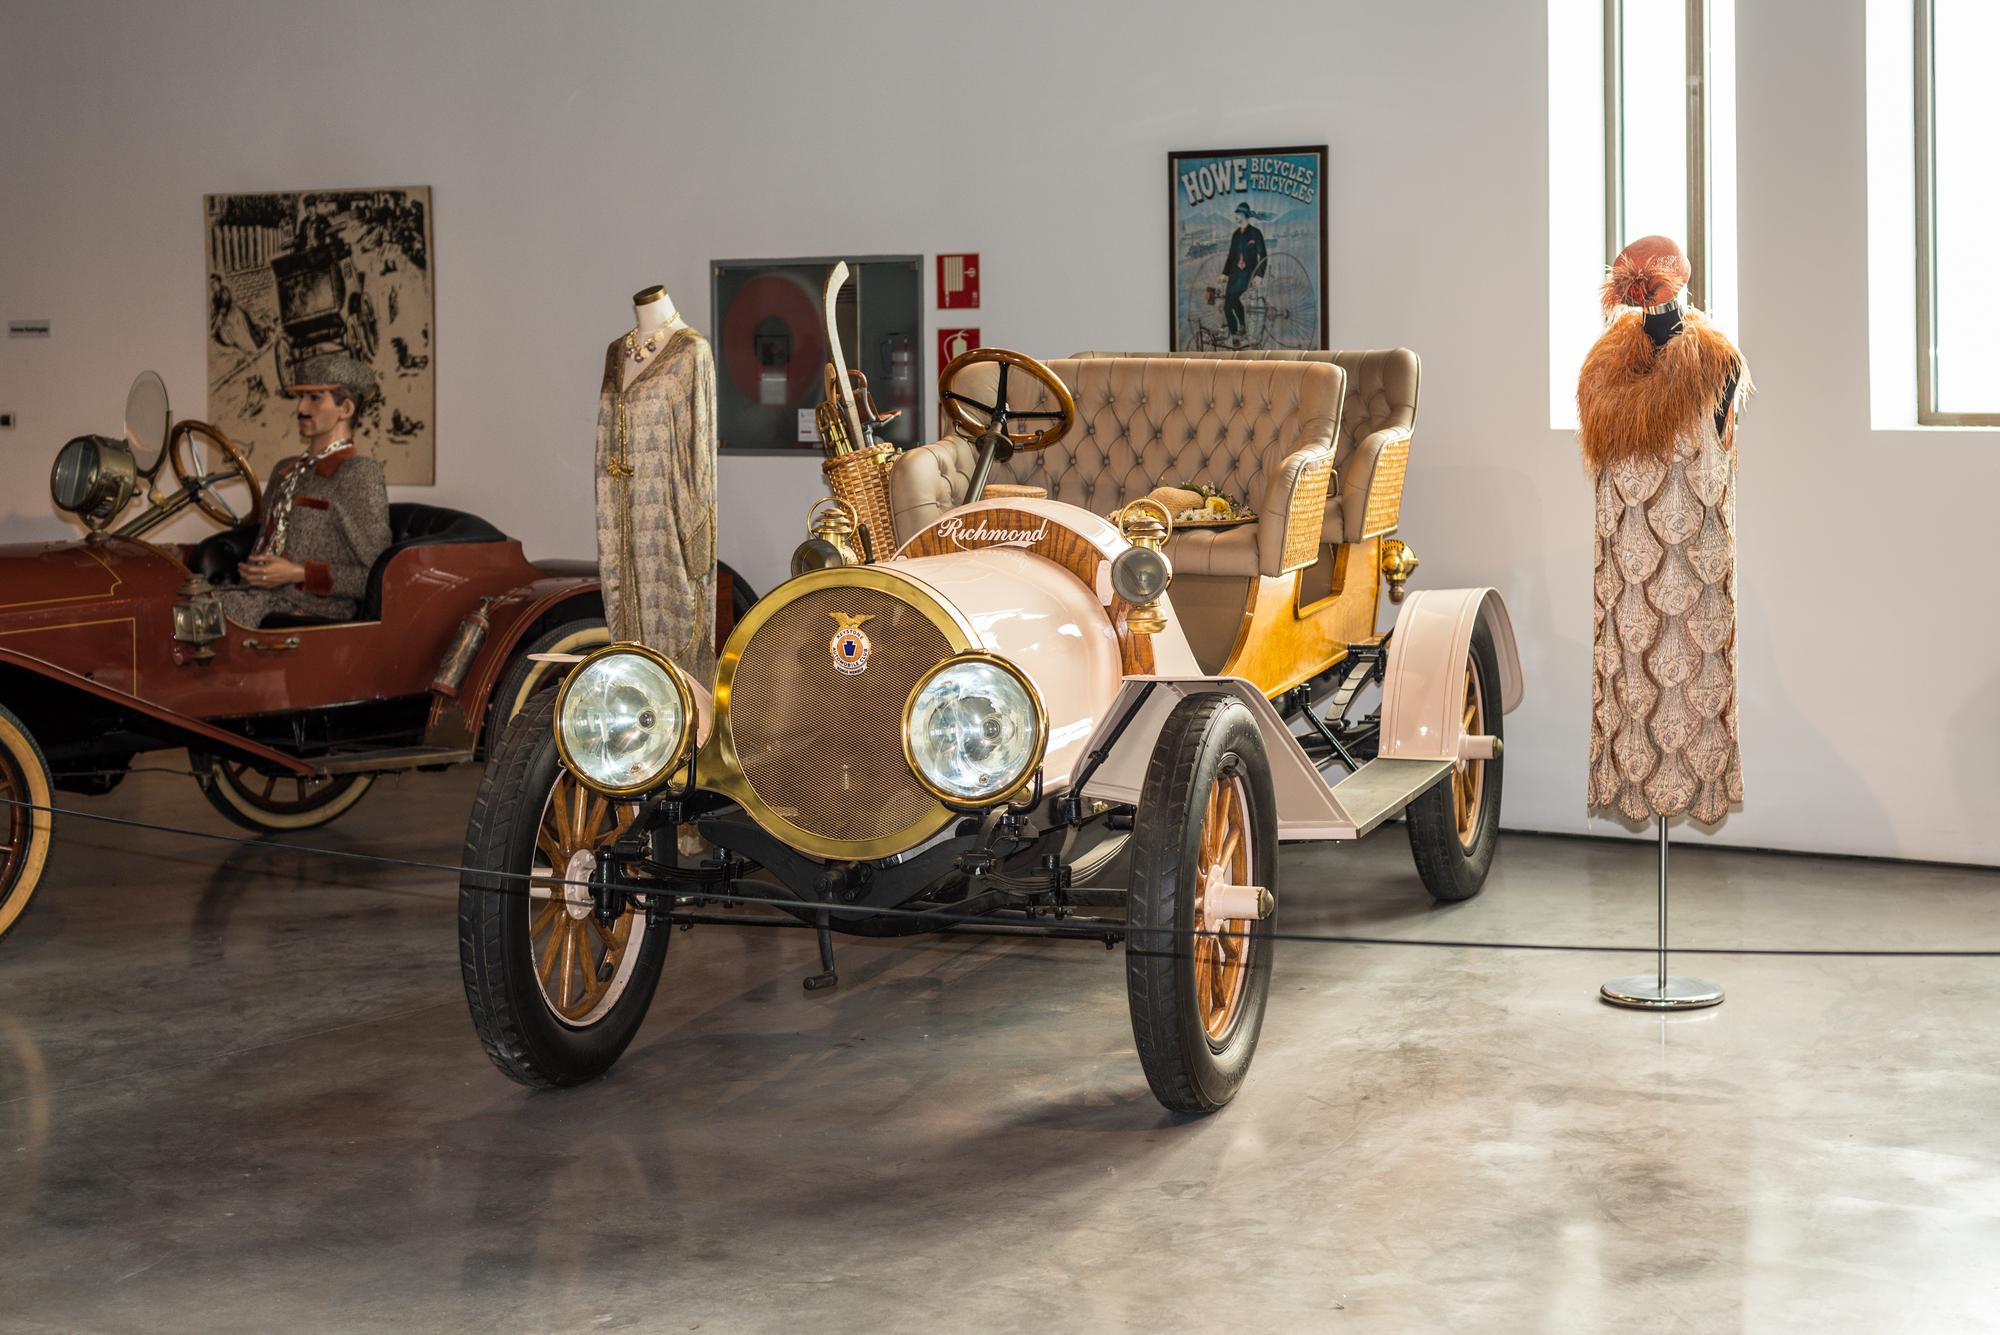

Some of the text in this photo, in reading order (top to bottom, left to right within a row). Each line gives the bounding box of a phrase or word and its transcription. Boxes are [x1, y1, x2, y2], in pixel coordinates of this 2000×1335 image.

[1182, 158, 1314, 205] HOWE BICYCLES
[1251, 173, 1315, 205] TRICYCLES
[937, 517, 1049, 551] Richmond
[837, 630, 864, 639] KEYSTONE
[832, 647, 868, 667] AUTOMOBILE CLUB
